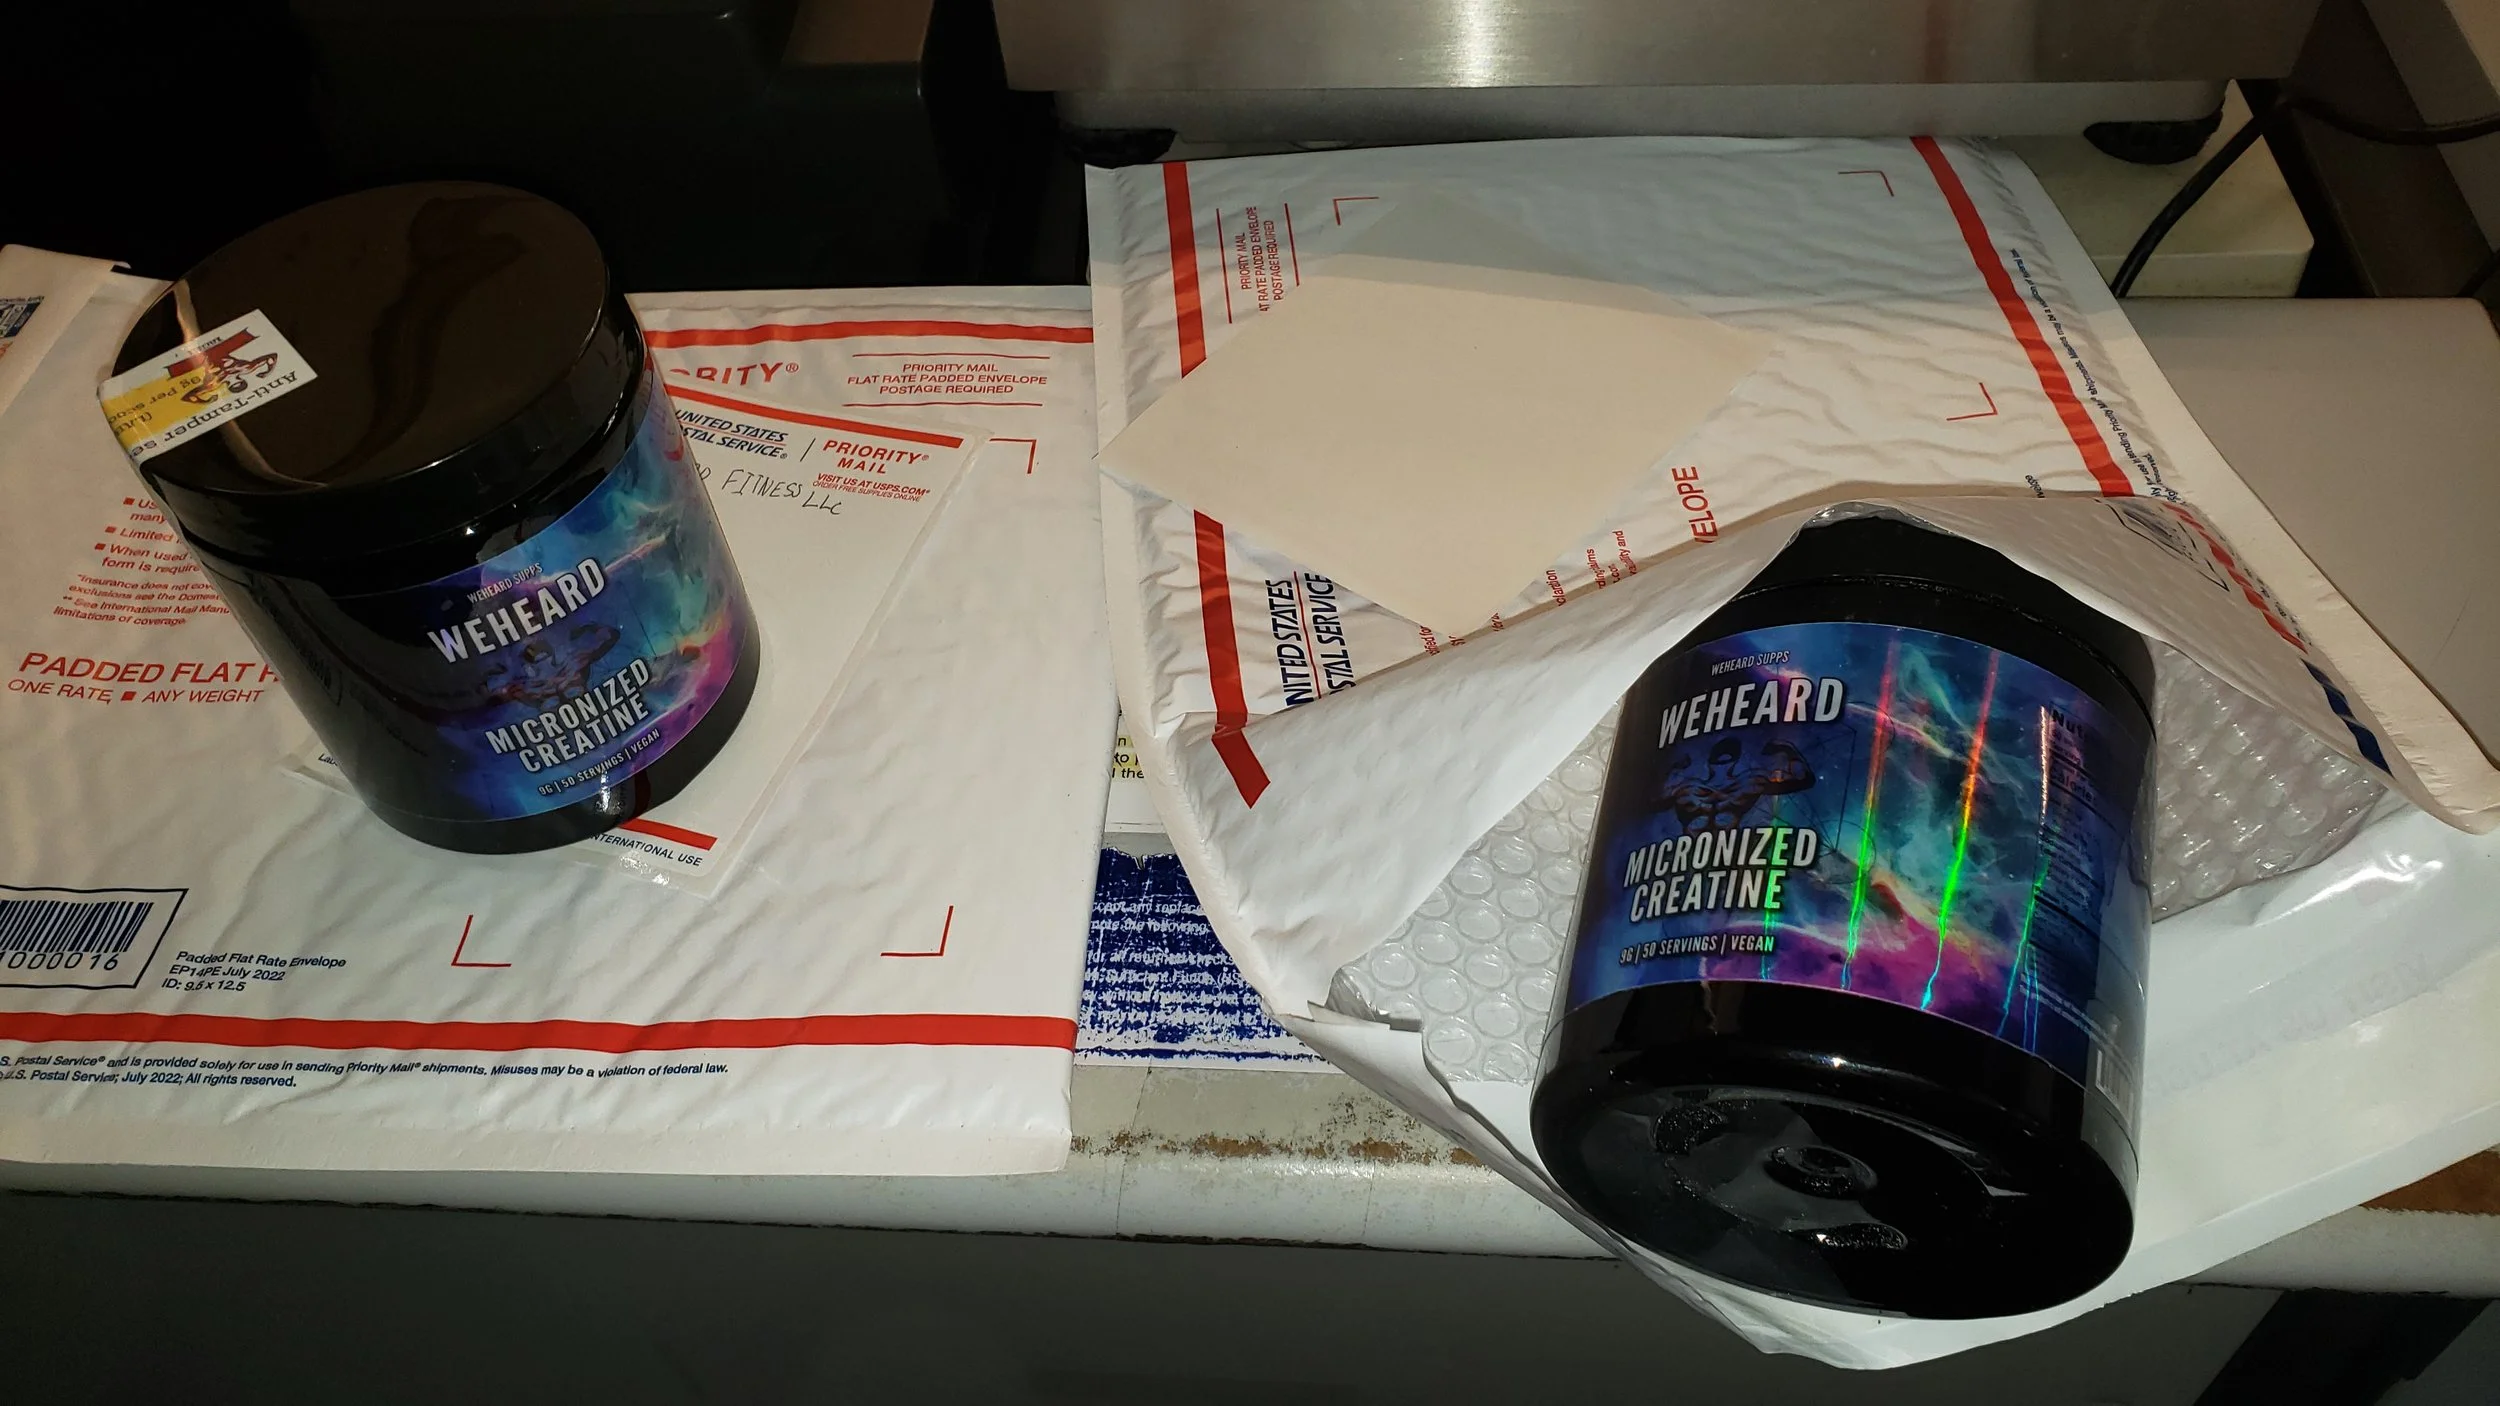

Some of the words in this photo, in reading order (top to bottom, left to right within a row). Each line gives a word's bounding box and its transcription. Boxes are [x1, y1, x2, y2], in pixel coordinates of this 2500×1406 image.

[1252, 244, 1265, 277] PADDED
[1269, 259, 1284, 301] POSTAGE
[903, 363, 964, 373] PRIORITY
[967, 363, 999, 372] MAIL
[847, 375, 880, 385] FLAT
[882, 374, 917, 383] RATE
[919, 374, 974, 383] PADDED
[977, 375, 1048, 385] ENVELOPE
[879, 385, 943, 395] POSTAGE
[946, 385, 1014, 394] REQUIRED
[164, 370, 298, 443] Anti-Tamper
[731, 424, 788, 442] STATES
[836, 457, 888, 475] MAIL
[812, 481, 839, 491] ORDER
[838, 484, 857, 494] FREE
[858, 487, 893, 498] SUPPLIES
[817, 473, 842, 481] VISIT
[843, 477, 858, 485] US
[858, 480, 873, 488] AT
[120, 528, 174, 542] Limited
[109, 544, 150, 557] When
[154, 551, 188, 562] used
[101, 557, 136, 570] form
[138, 561, 151, 572] is
[69, 585, 132, 600] exclusions
[157, 592, 176, 601] the
[141, 581, 169, 591] does
[171, 583, 189, 591] not
[467, 578, 512, 604] WEHEARD
[512, 562, 543, 584] SUPPS
[53, 606, 116, 622] limitations
[118, 615, 132, 623] of
[100, 601, 171, 614] International
[174, 604, 198, 615] Mail
[427, 557, 606, 664] WEHEARD
[1265, 579, 1302, 641] STATES
[1304, 572, 1346, 646] SERVICE
[18, 652, 166, 684] PADDED
[170, 661, 255, 683] FLAT
[1711, 654, 1755, 676] WEHEARD
[1756, 650, 1790, 668] SUPPS
[7, 679, 55, 694] ONE
[57, 684, 114, 702] RATE
[141, 689, 185, 703] ANY
[188, 688, 265, 703] WEIGHT
[484, 658, 649, 755] MICRONIZED
[1657, 676, 1845, 750] WEHEARD
[518, 692, 649, 773] CREATINE
[561, 777, 575, 789] 50
[576, 752, 625, 783] SERVINGS
[631, 728, 661, 754] VEGAN
[589, 832, 674, 860] NTERNATIONAL
[677, 853, 703, 866] USE
[1623, 827, 1818, 888] MICRONIZED
[1629, 870, 1784, 924] CREATINE
[1641, 941, 1657, 959] 50
[1658, 936, 1717, 958] SERVINGS
[1731, 934, 1775, 953] VEGAN
[176, 950, 229, 964] Padded
[229, 952, 254, 964] Flat
[255, 953, 287, 968] Rate
[289, 956, 346, 970] Envelope
[168, 964, 221, 978] EP14PE
[222, 965, 252, 979] July
[253, 968, 286, 981] 2022
[161, 978, 182, 990] ID:
[204, 982, 214, 990] x
[218, 980, 247, 992] 12.5
[15, 1056, 52, 1066] Postal
[107, 1058, 129, 1067] and
[130, 1057, 141, 1066] is
[143, 1057, 199, 1069] provided
[199, 1059, 236, 1072] solely
[237, 1059, 255, 1071] for
[257, 1062, 279, 1071] use
[281, 1060, 294, 1071] in
[295, 1060, 345, 1075] sending
[347, 1060, 387, 1074] Priority
[422, 1062, 488, 1075] shipments.
[490, 1066, 539, 1076] Misuses
[541, 1065, 566, 1077] may
[568, 1064, 584, 1075] be
[586, 1068, 595, 1077] a
[598, 1064, 645, 1078] violation
[648, 1064, 663, 1076] of
[663, 1062, 703, 1075] federal
[705, 1062, 728, 1073] law.
[31, 1070, 70, 1081] Postal
[121, 1071, 148, 1084] July
[150, 1072, 183, 1085] 2022;
[184, 1072, 202, 1083] All
[203, 1072, 237, 1086] rights
[240, 1075, 297, 1088] reserved.
